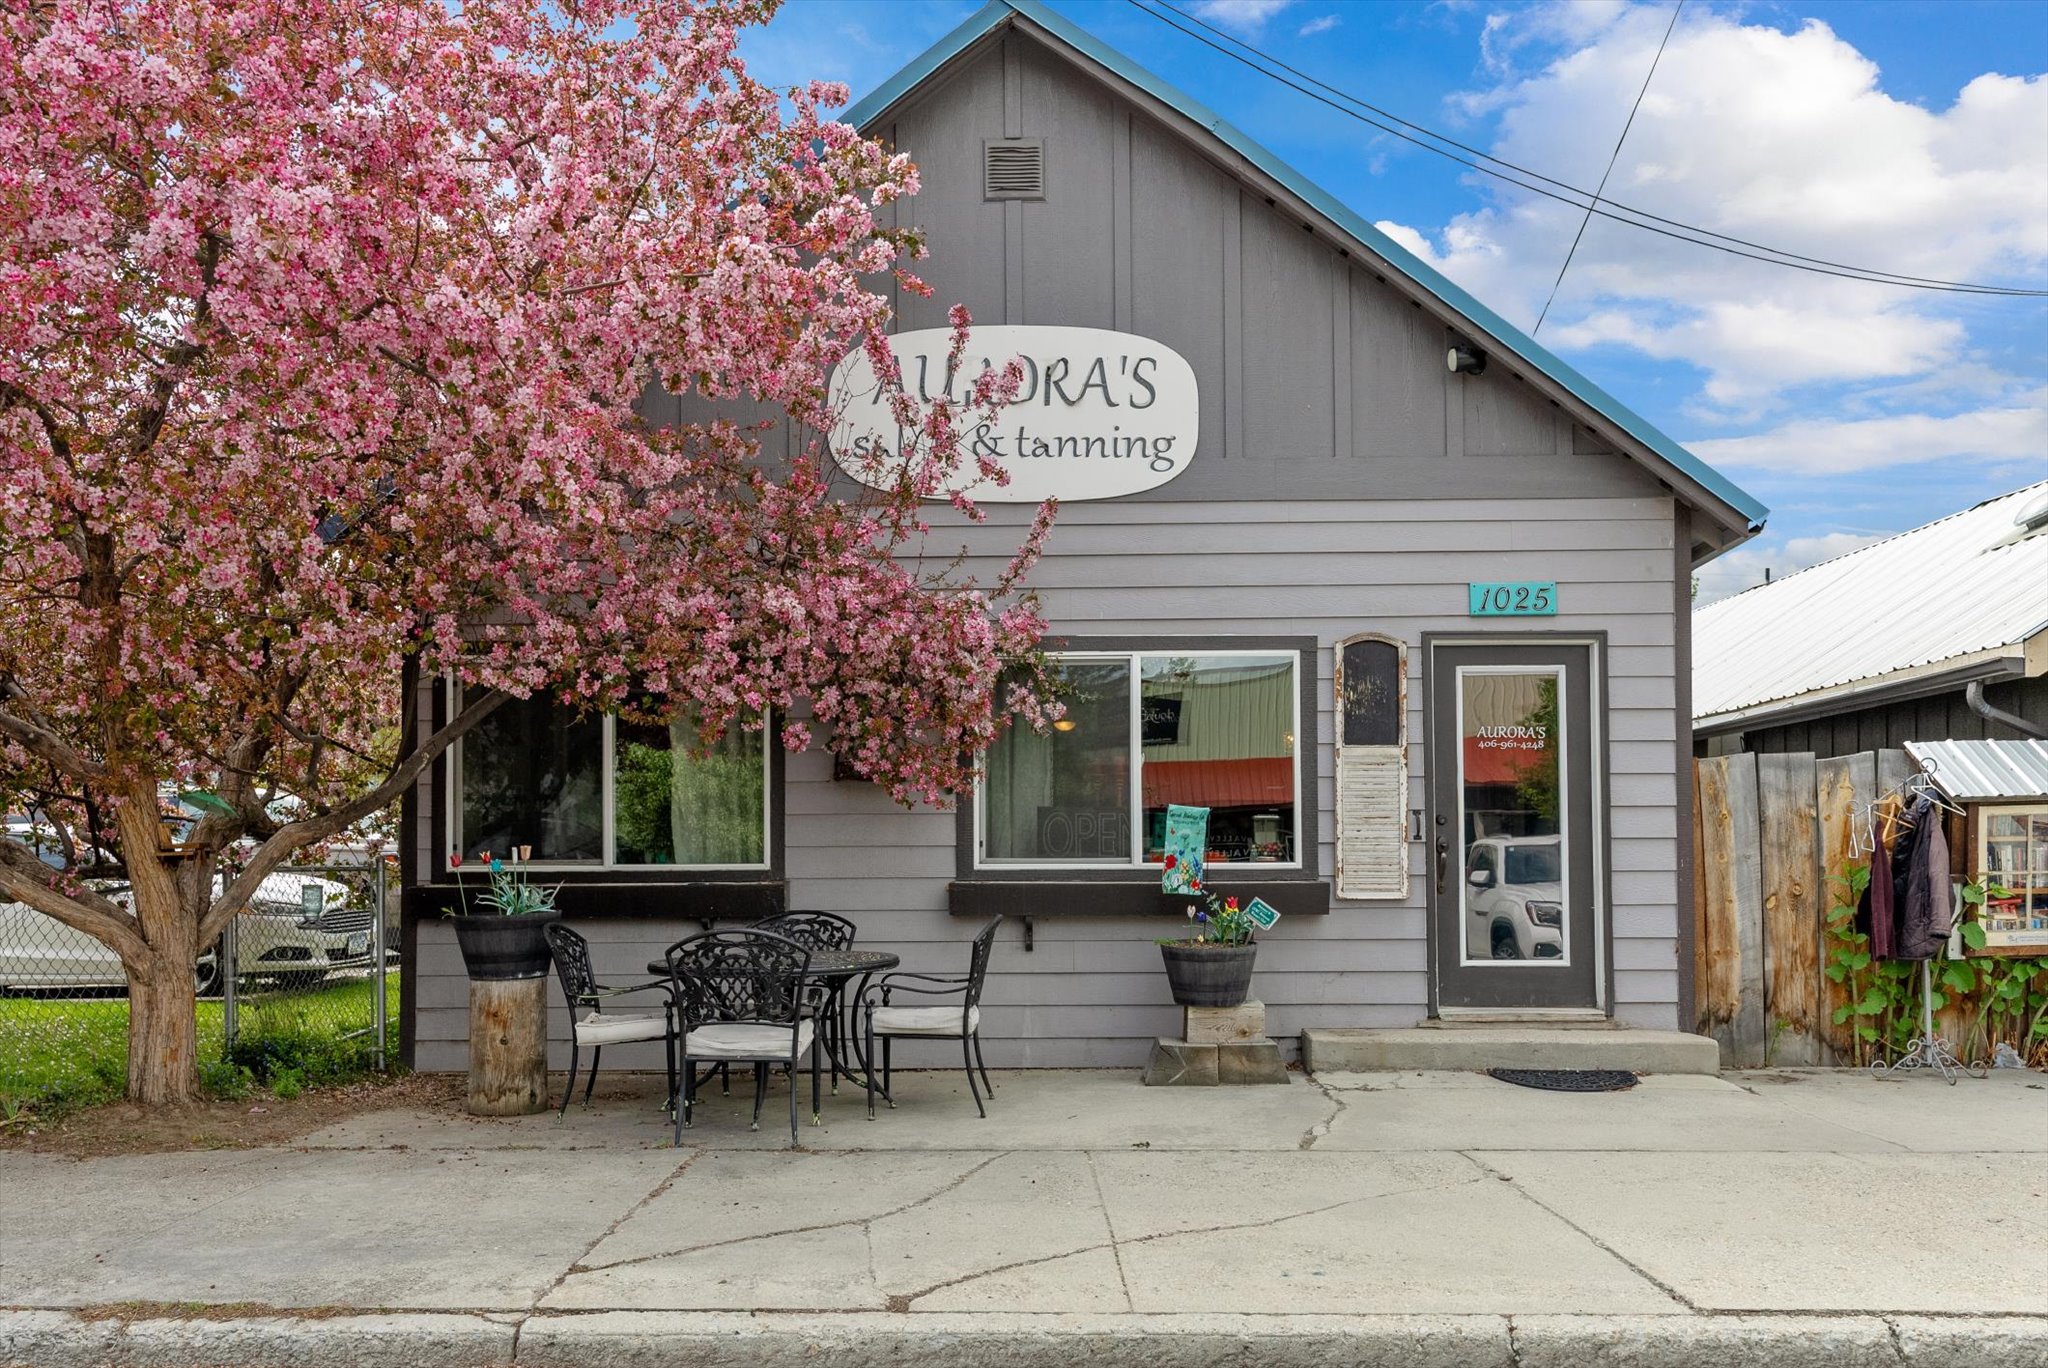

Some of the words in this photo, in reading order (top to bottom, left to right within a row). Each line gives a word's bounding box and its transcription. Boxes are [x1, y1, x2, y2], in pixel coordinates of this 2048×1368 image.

[972, 424, 1008, 456] &
[1014, 426, 1177, 472] tanning
[1479, 586, 1551, 612] 1025
[1476, 726, 1546, 739] AURORA'S
[1478, 739, 1544, 750] 406-961-4248
